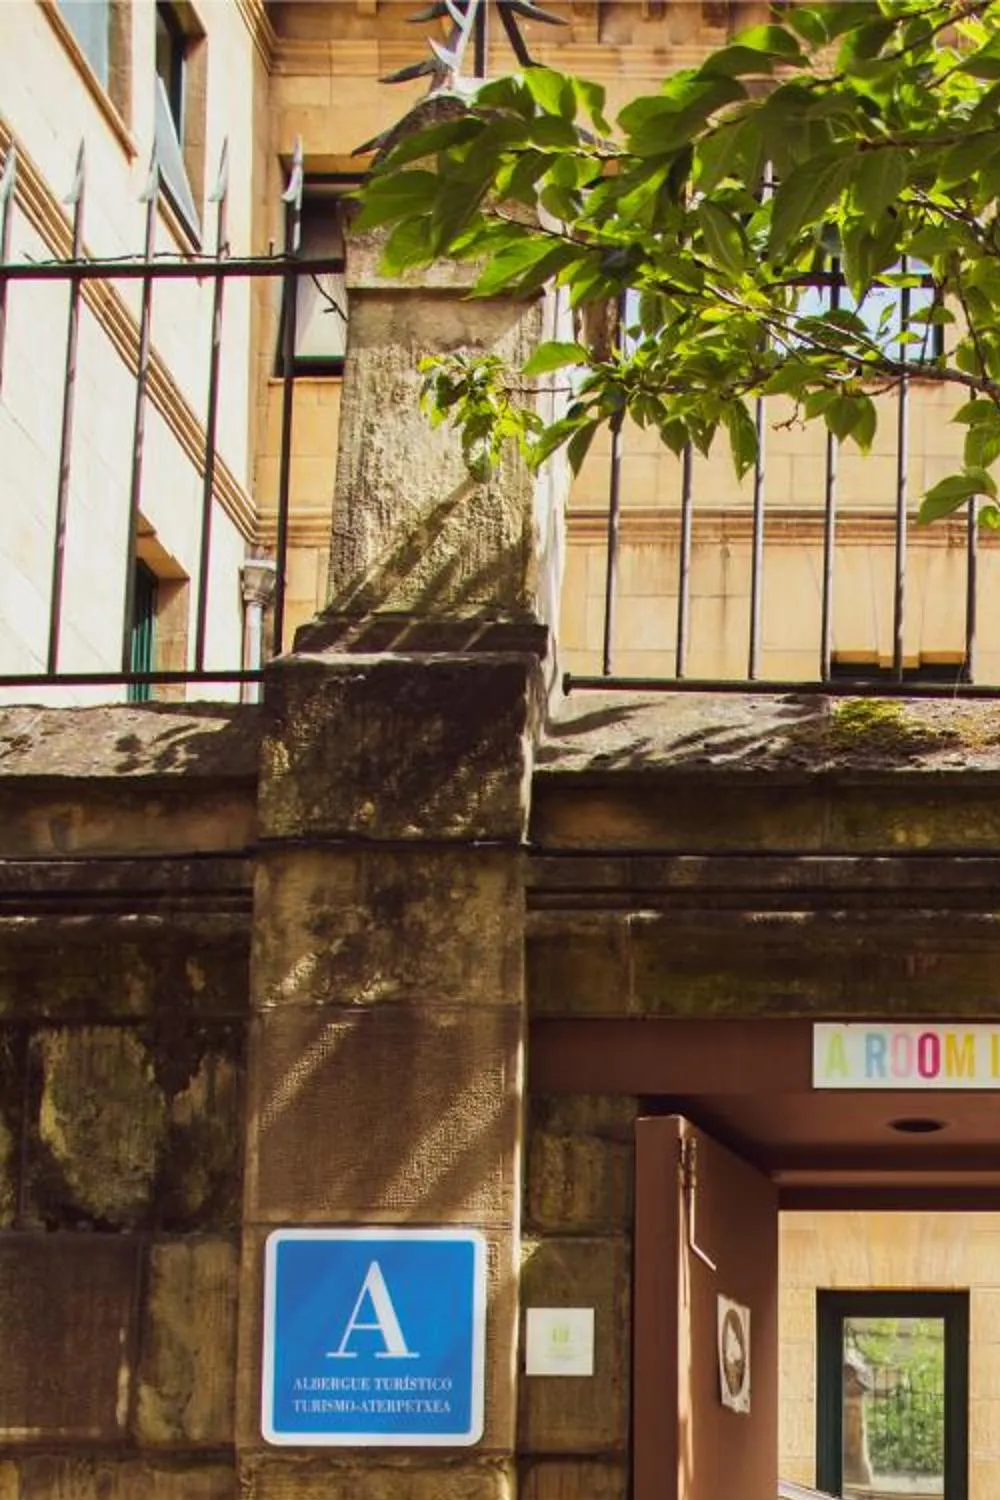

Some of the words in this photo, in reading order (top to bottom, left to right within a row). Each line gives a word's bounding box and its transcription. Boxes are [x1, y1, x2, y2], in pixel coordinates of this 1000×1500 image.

[825, 1031, 849, 1078] A
[864, 1031, 976, 1079] ROOM
[325, 1260, 420, 1359] A
[292, 1377, 371, 1392] ALBERGUE
[373, 1374, 453, 1392] TURÍSTICO
[292, 1398, 451, 1414] TURISMO-ATERPETXEA
